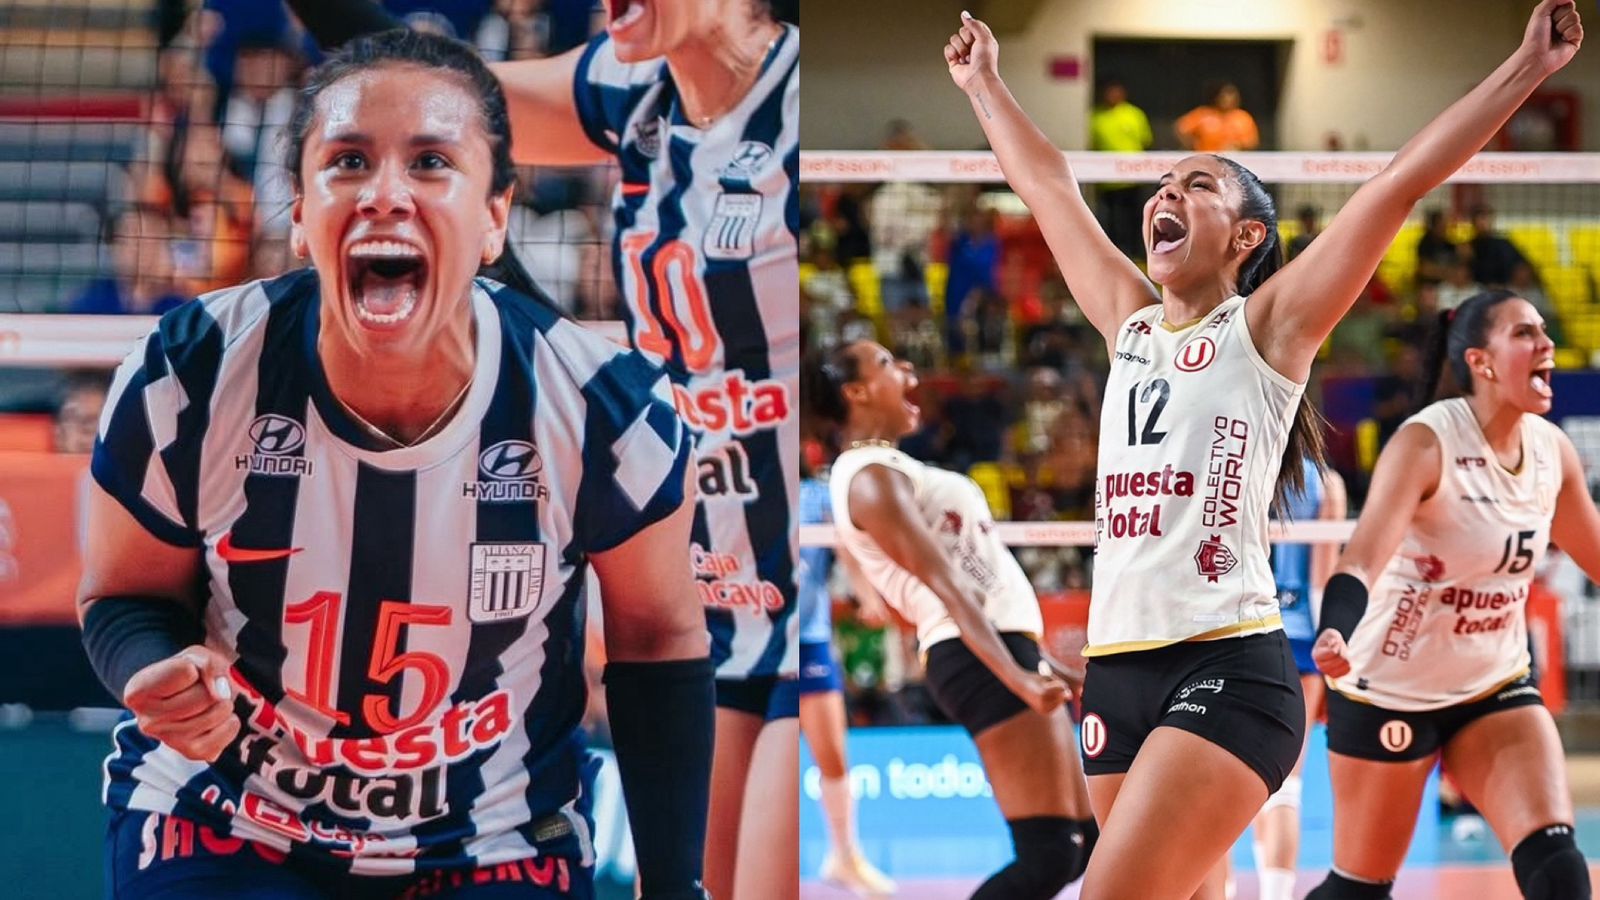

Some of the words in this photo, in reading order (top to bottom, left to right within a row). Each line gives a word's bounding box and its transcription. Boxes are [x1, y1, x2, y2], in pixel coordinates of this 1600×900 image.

[621, 230, 718, 371] 10
[1183, 342, 1206, 367] U
[1127, 379, 1171, 446] 12
[463, 482, 550, 503] HYUNDA
[1106, 464, 1194, 508] puesta
[1203, 416, 1228, 527] COLECTIVO
[1218, 419, 1248, 528] WORLD
[1108, 504, 1162, 539] total
[1493, 530, 1536, 574] 15
[284, 590, 452, 733] 15
[1387, 726, 1405, 749] U
